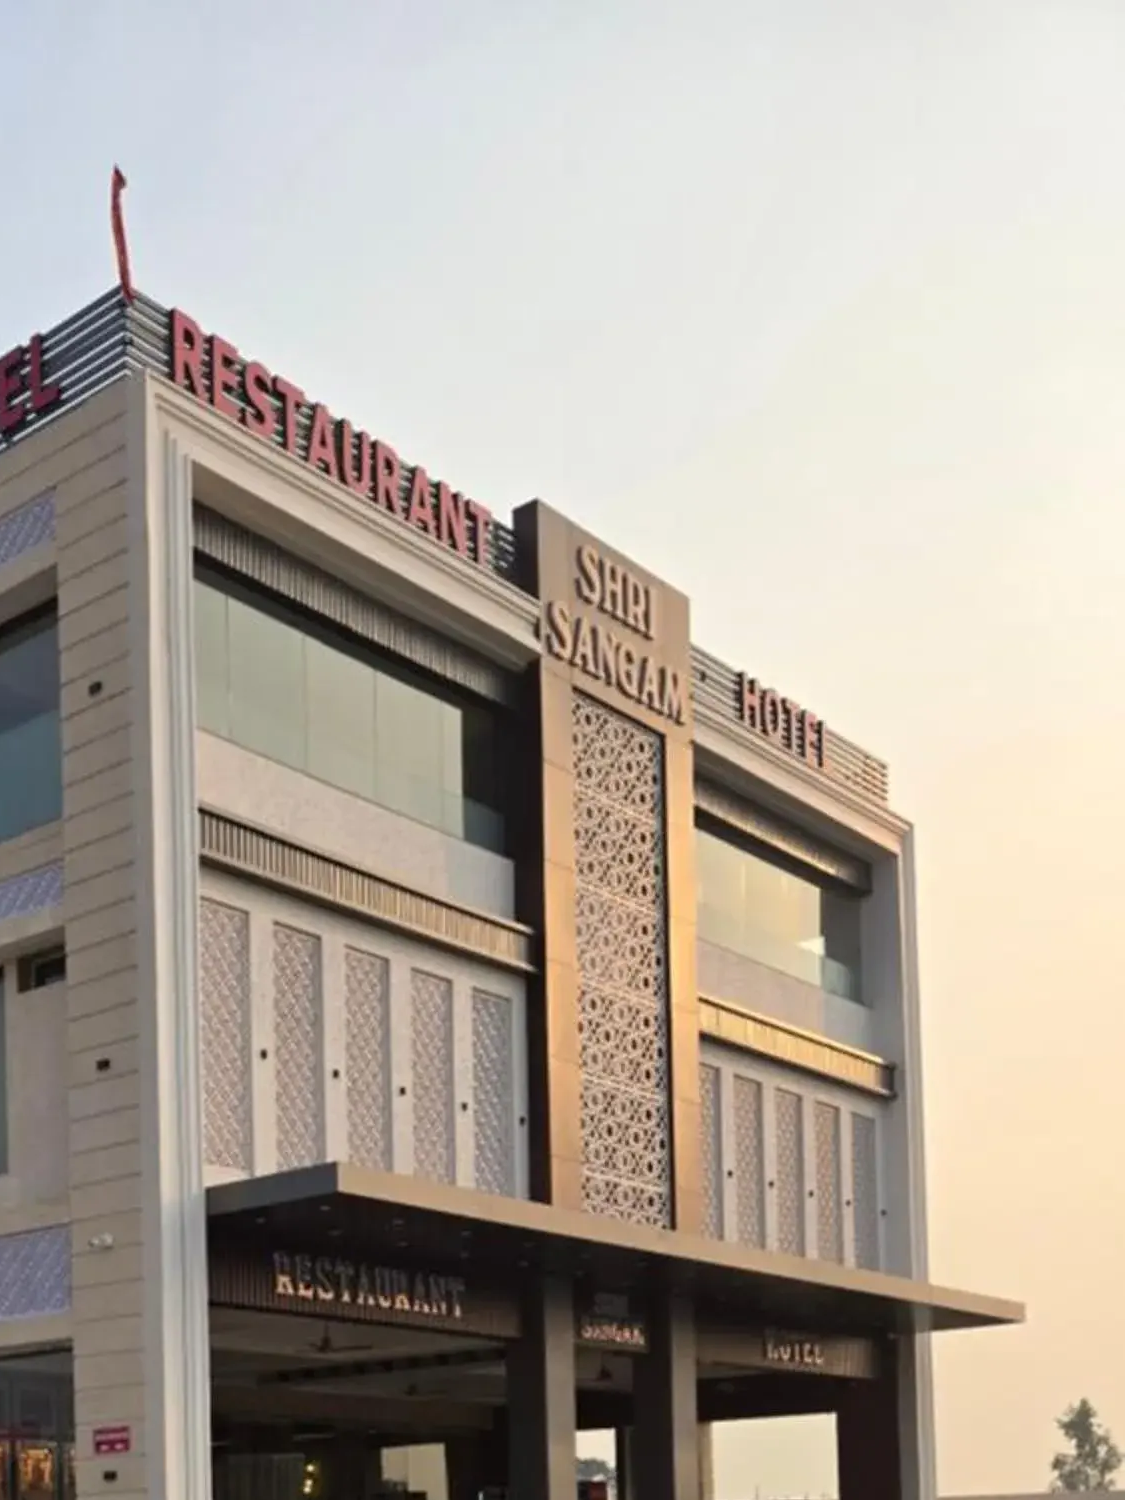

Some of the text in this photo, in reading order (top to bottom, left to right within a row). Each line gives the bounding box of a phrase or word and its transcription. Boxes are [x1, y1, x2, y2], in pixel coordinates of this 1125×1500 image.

[171, 307, 493, 568] RESTAURANT
[576, 543, 657, 641] SHRI
[546, 600, 686, 727] SANGAM
[734, 671, 832, 774] HOTEL
[273, 1251, 465, 1318] RESTAURANT
